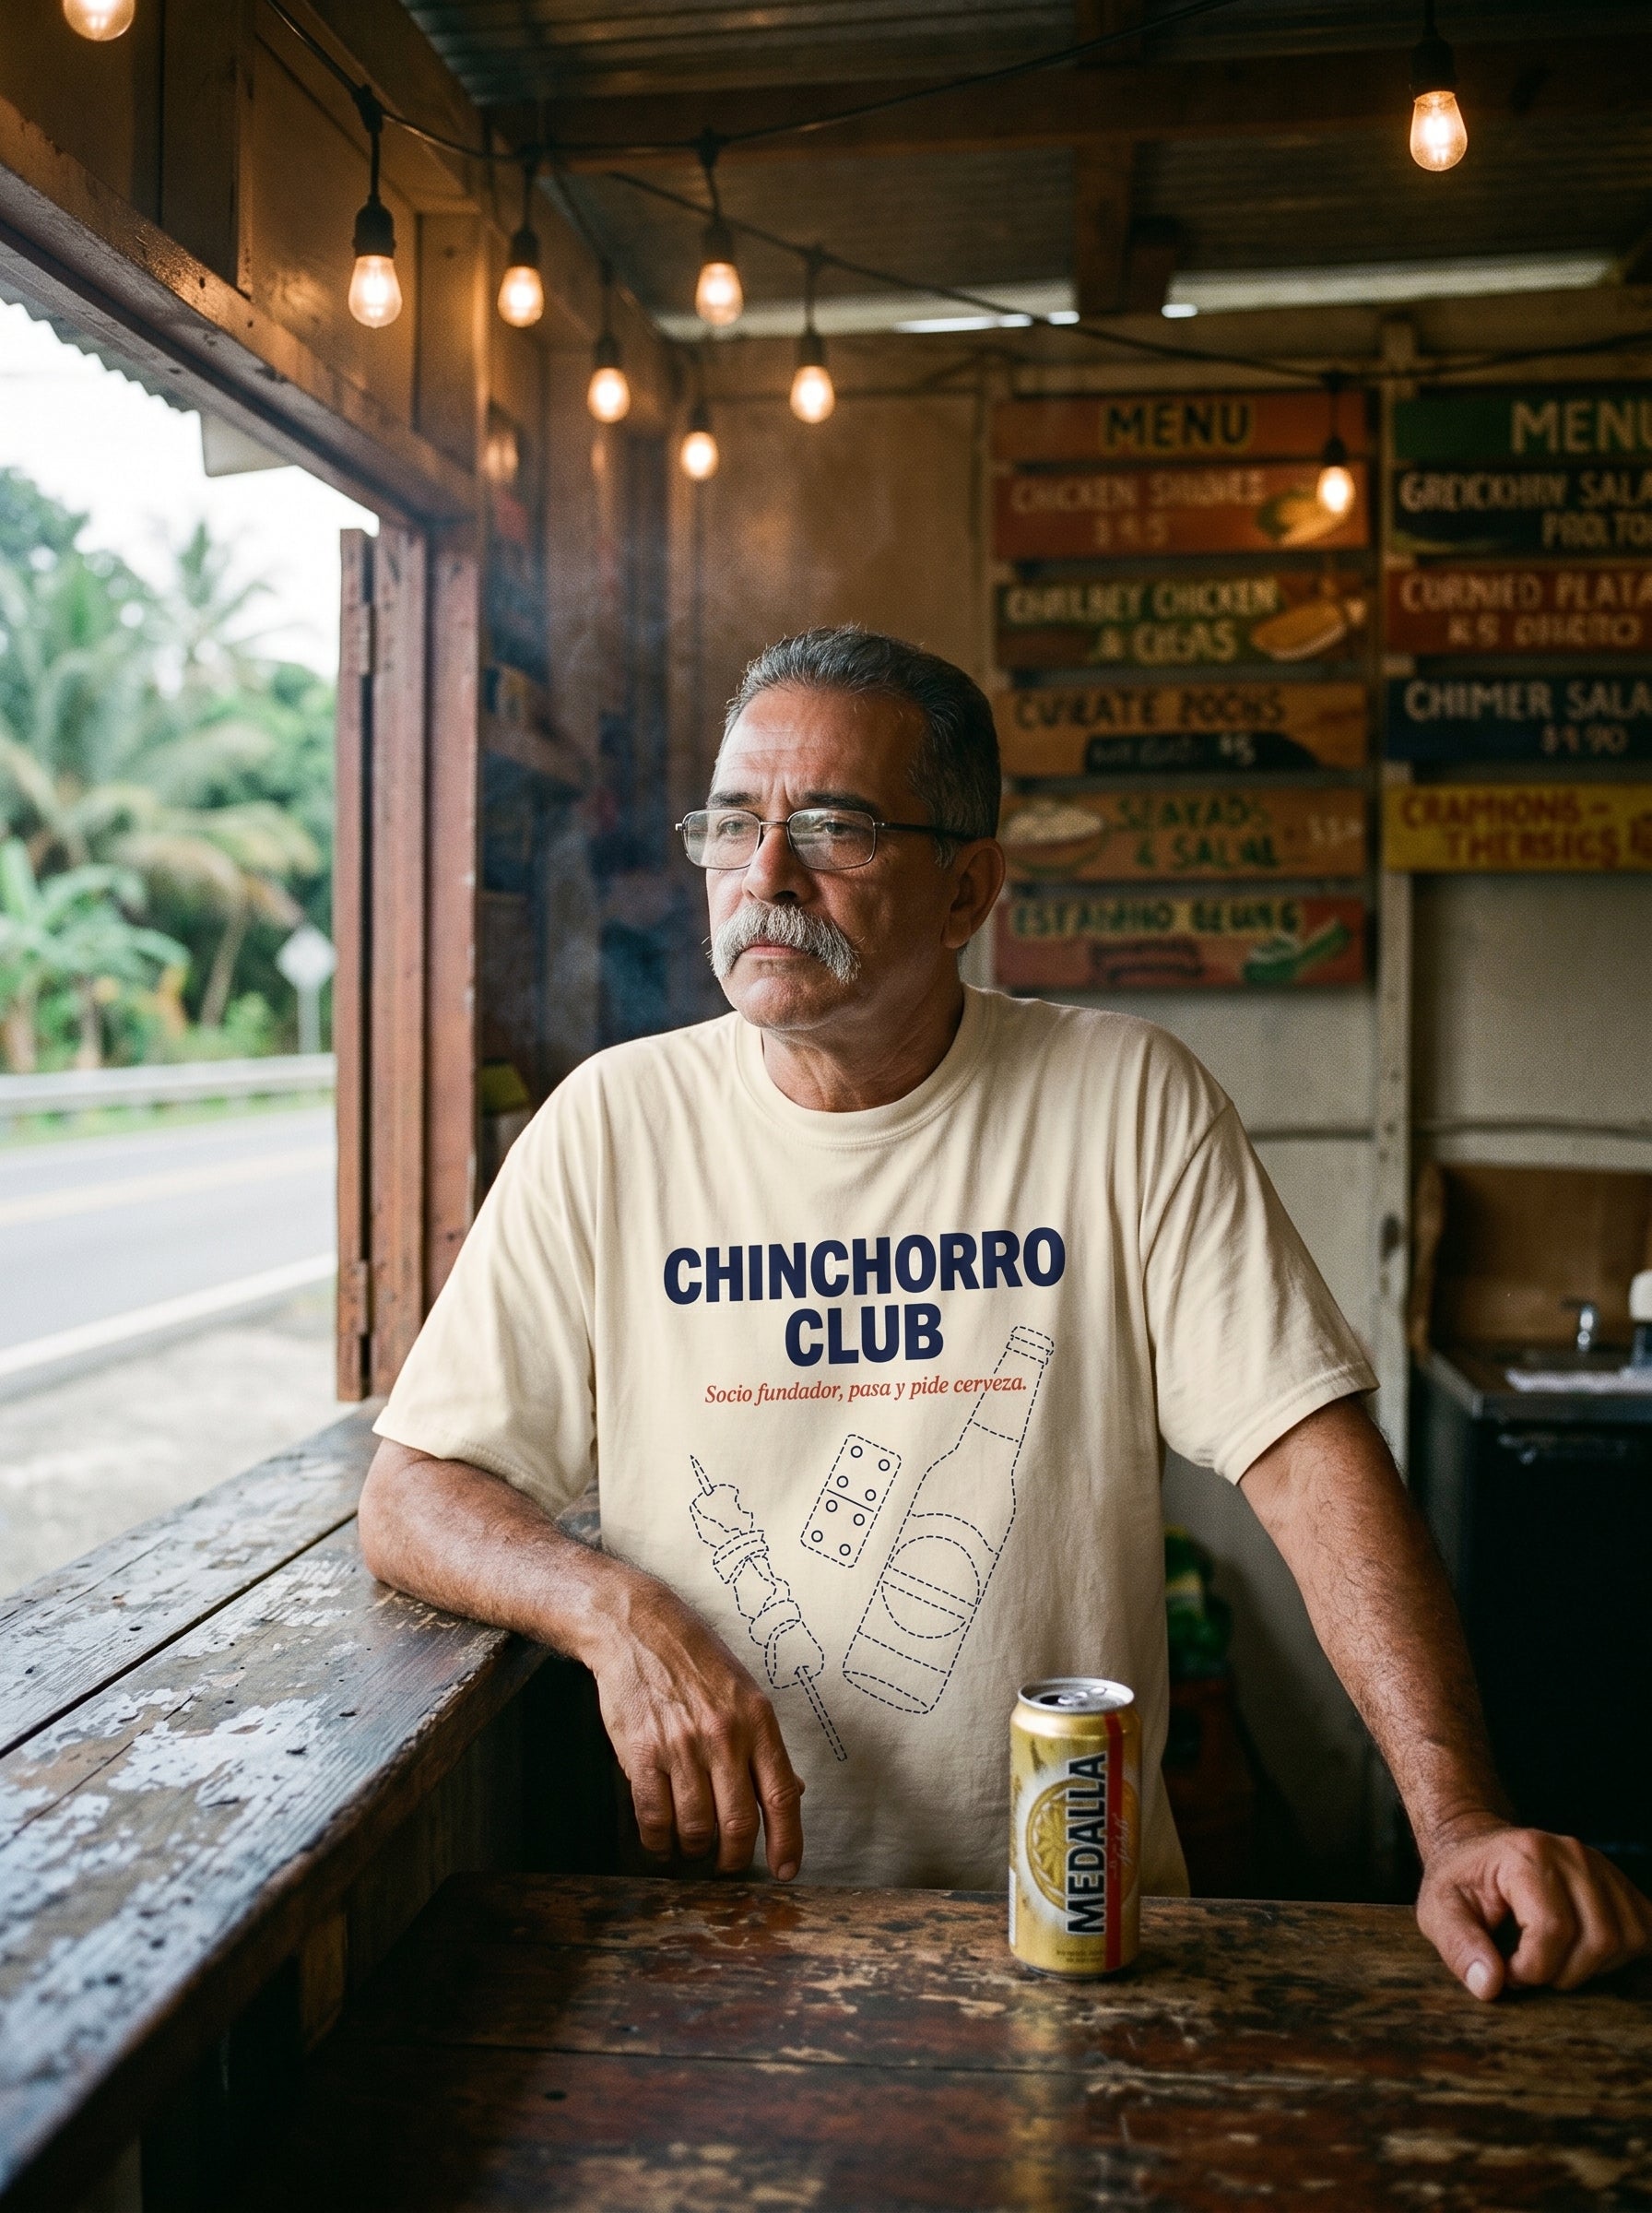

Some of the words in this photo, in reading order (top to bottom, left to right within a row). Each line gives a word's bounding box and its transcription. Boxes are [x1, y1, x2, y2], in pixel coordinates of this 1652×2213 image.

[1103, 397, 1257, 453] MENU
[664, 1227, 1065, 1305] CHINCHORRO
[785, 1303, 944, 1367] CLUB
[704, 1385, 753, 1403] Socio
[753, 1381, 844, 1407] fundador,
[847, 1383, 891, 1402] pasa
[893, 1384, 906, 1401] y
[909, 1376, 950, 1400] pide
[953, 1374, 1028, 1393] cerveza.
[1067, 1751, 1107, 1935] MEDALLA
